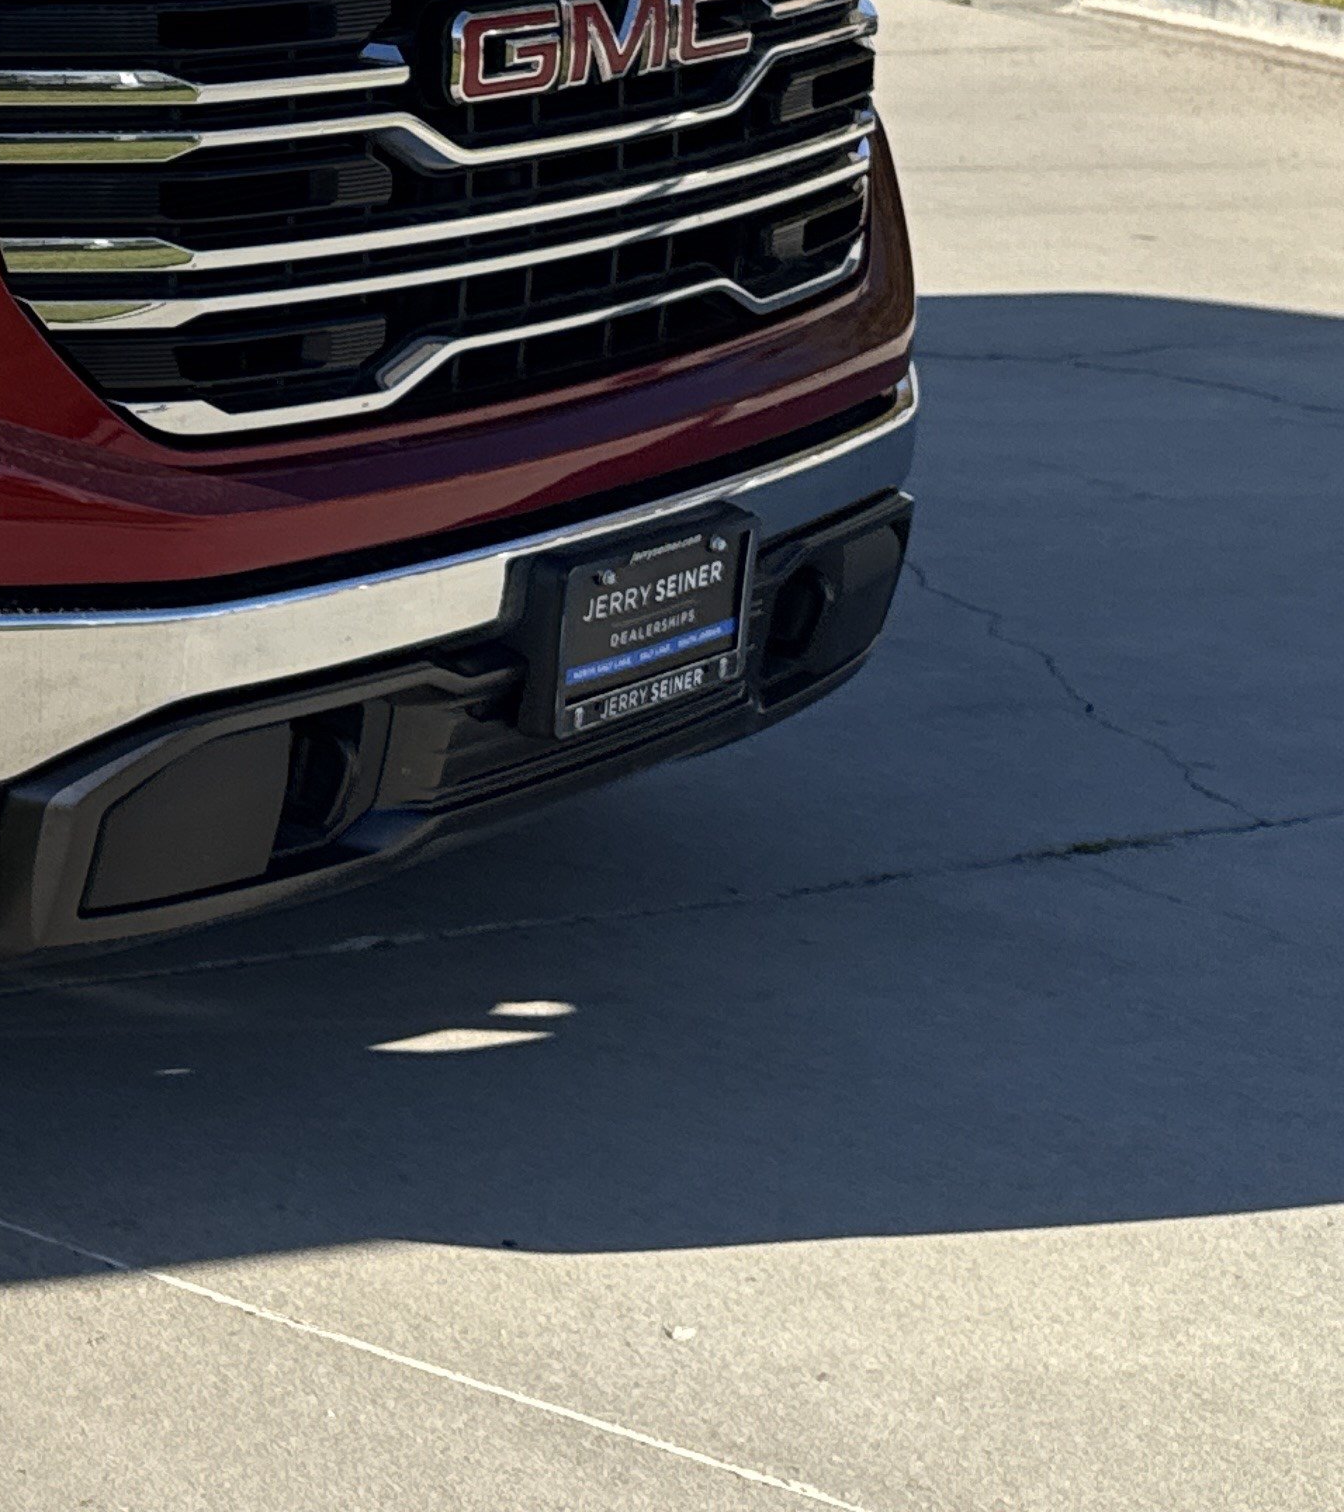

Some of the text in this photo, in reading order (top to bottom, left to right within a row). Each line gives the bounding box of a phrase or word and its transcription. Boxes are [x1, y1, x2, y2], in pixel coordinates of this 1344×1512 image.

[583, 560, 723, 623] JERRY SEINER
[609, 607, 697, 649] DEALERSHIPS
[599, 667, 706, 719] JERRY SEINER
